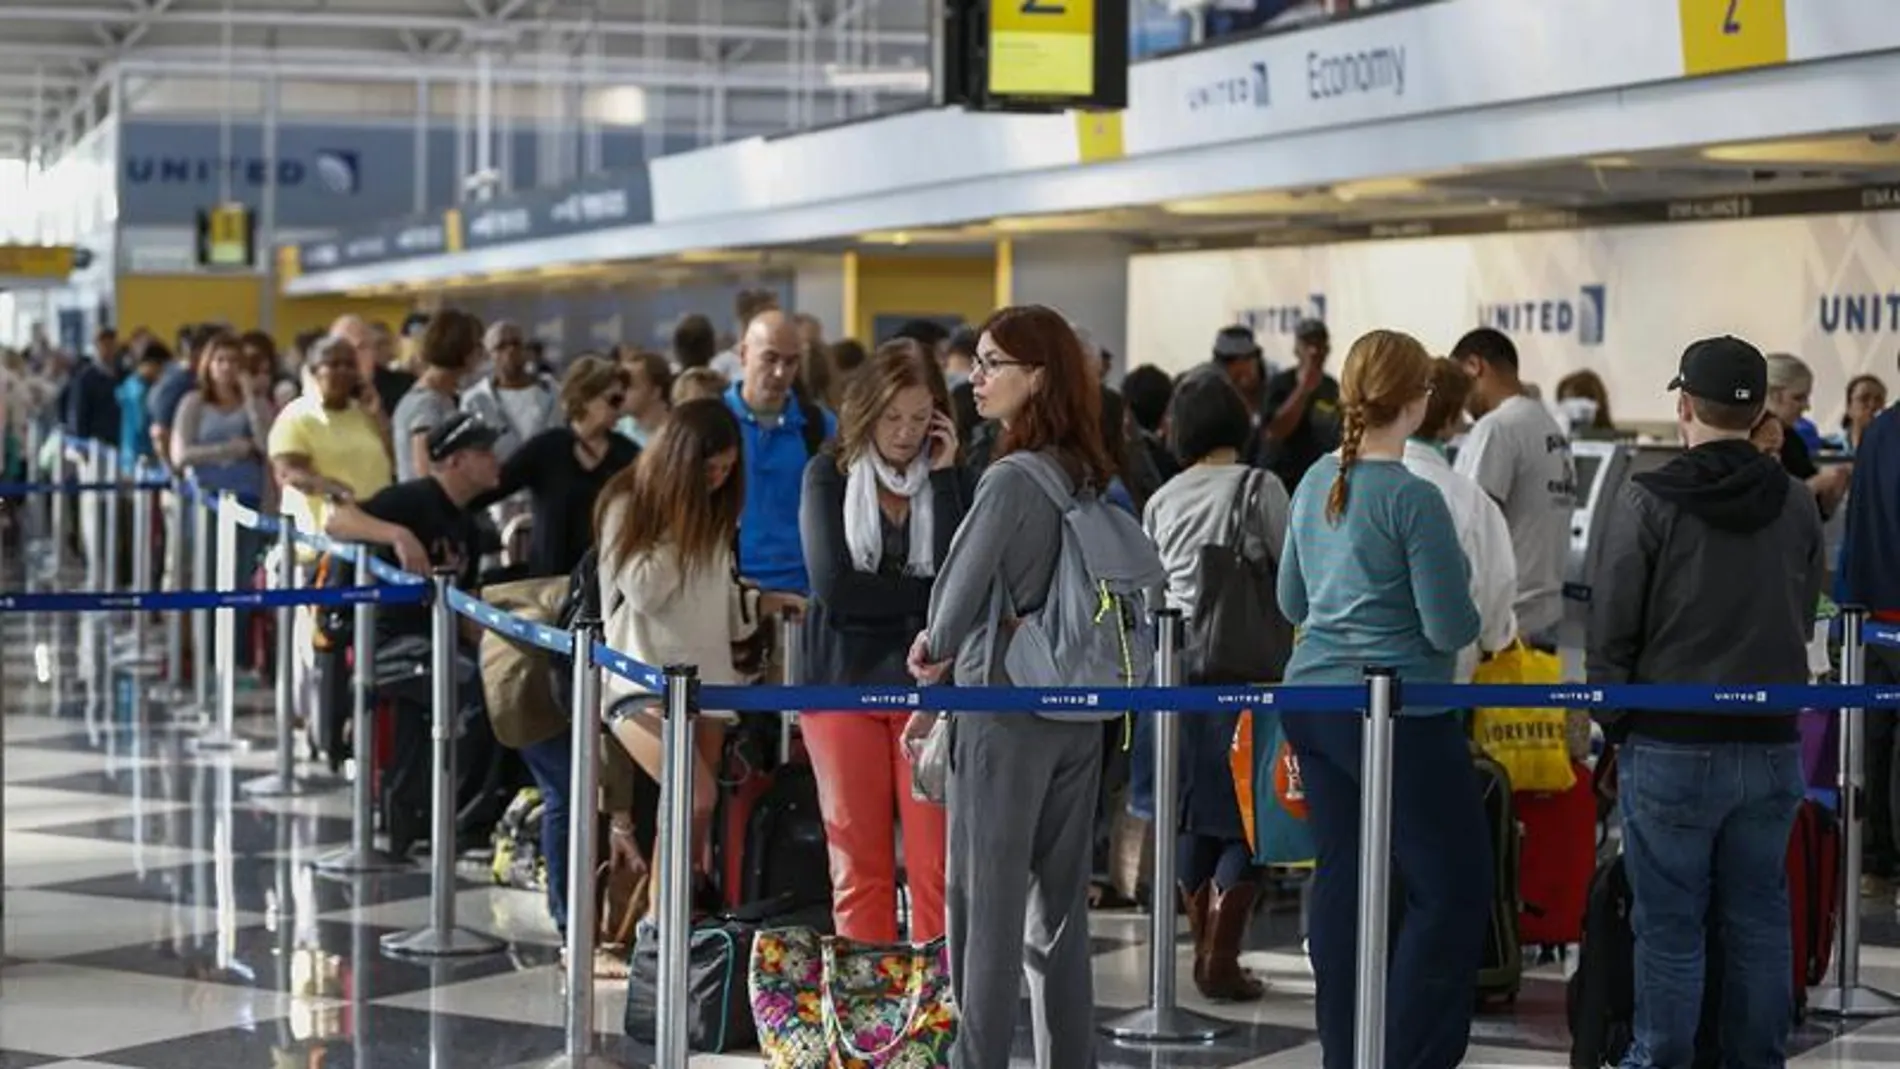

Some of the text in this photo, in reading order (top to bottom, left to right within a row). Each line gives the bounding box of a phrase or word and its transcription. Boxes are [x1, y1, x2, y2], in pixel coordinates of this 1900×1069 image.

[1307, 46, 1405, 99] Economy
[1477, 300, 1573, 334] UNITED
[861, 695, 906, 703] UNITED
[1041, 695, 1085, 704] UNITED
[1714, 692, 1755, 701] UNITED
